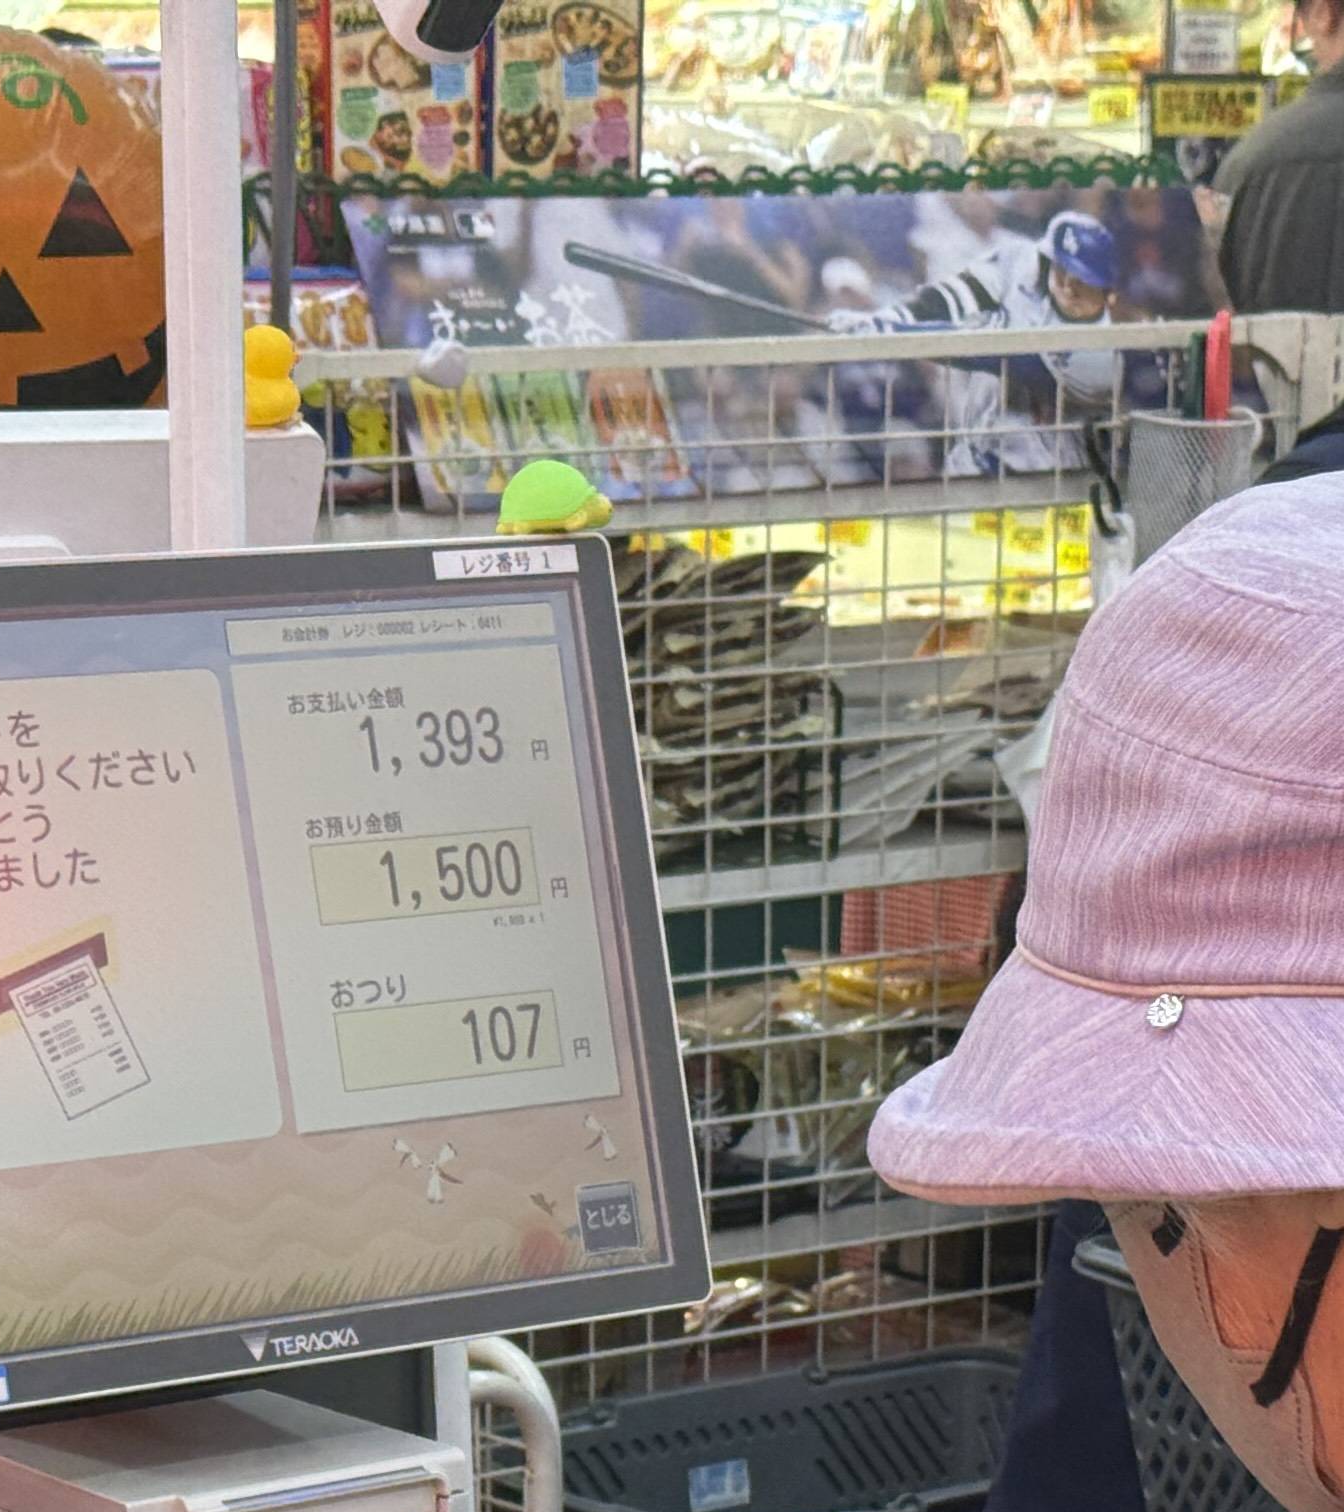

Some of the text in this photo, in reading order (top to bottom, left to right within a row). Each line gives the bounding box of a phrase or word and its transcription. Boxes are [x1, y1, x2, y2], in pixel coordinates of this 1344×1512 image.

[462, 553, 552, 575] レジ番号 1
[287, 687, 405, 715] お支払い金額
[360, 706, 550, 777] 1,393 円
[304, 813, 404, 840] お預り金額
[379, 839, 570, 910] 1,500 円
[330, 974, 408, 1009] おつり
[461, 1002, 592, 1066] 107 円
[586, 1203, 632, 1230] とじる
[268, 1326, 360, 1357] TERAOKA
